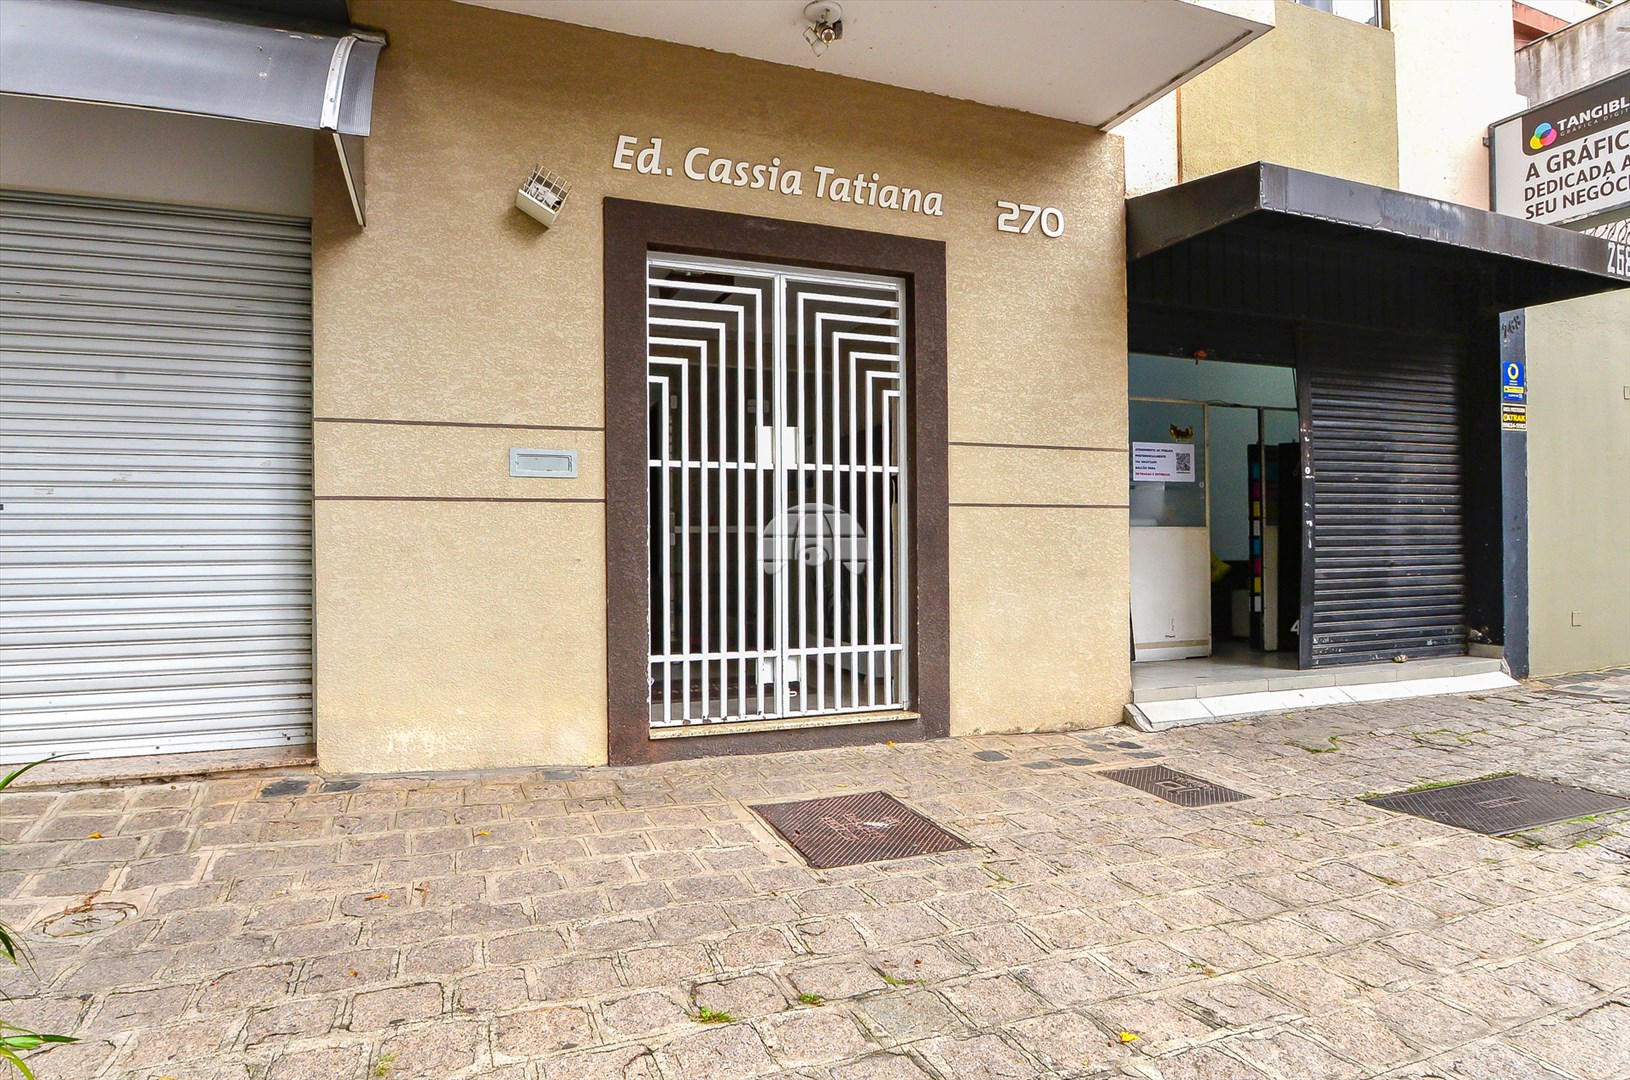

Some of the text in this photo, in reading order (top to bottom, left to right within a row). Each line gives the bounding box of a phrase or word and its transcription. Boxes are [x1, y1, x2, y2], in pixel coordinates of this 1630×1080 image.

[1557, 96, 1630, 131] TANGIBL
[612, 134, 944, 217] Ed. Cassia Tatiana
[1525, 130, 1629, 182] A GRÁFIC
[1524, 160, 1616, 202] DEDICADA
[997, 200, 1065, 238] 270
[1525, 197, 1557, 220] SEU
